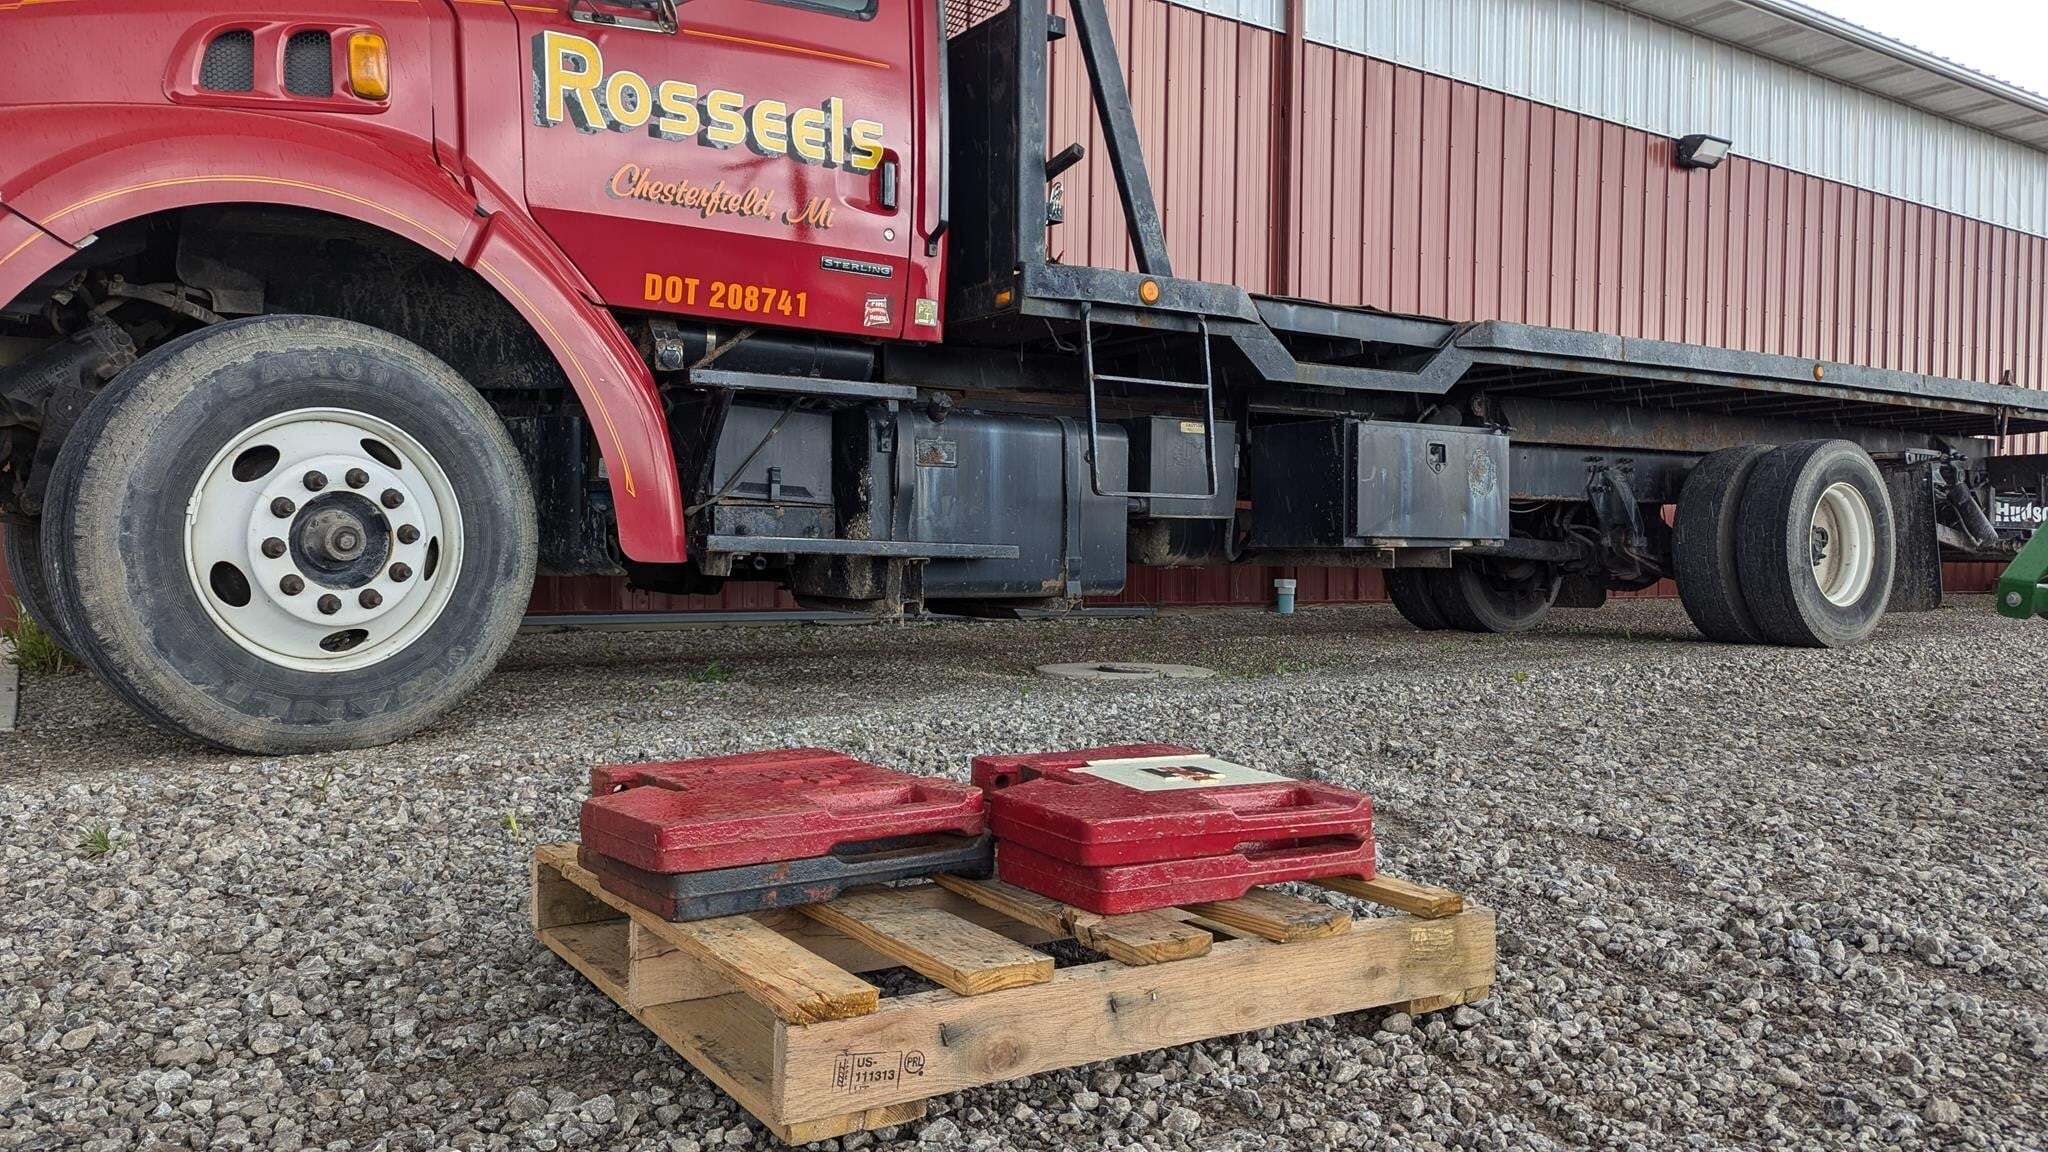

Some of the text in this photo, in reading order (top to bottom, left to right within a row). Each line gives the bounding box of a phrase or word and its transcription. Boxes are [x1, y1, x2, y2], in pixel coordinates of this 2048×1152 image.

[540, 29, 886, 173] Rosseels
[608, 162, 834, 229] Chesterfield, Mi
[823, 258, 891, 275] STERLING
[644, 272, 808, 318] DOT 208741
[857, 1057, 877, 1068] US-
[906, 1055, 924, 1068] PRL
[855, 1069, 895, 1082] 111313
